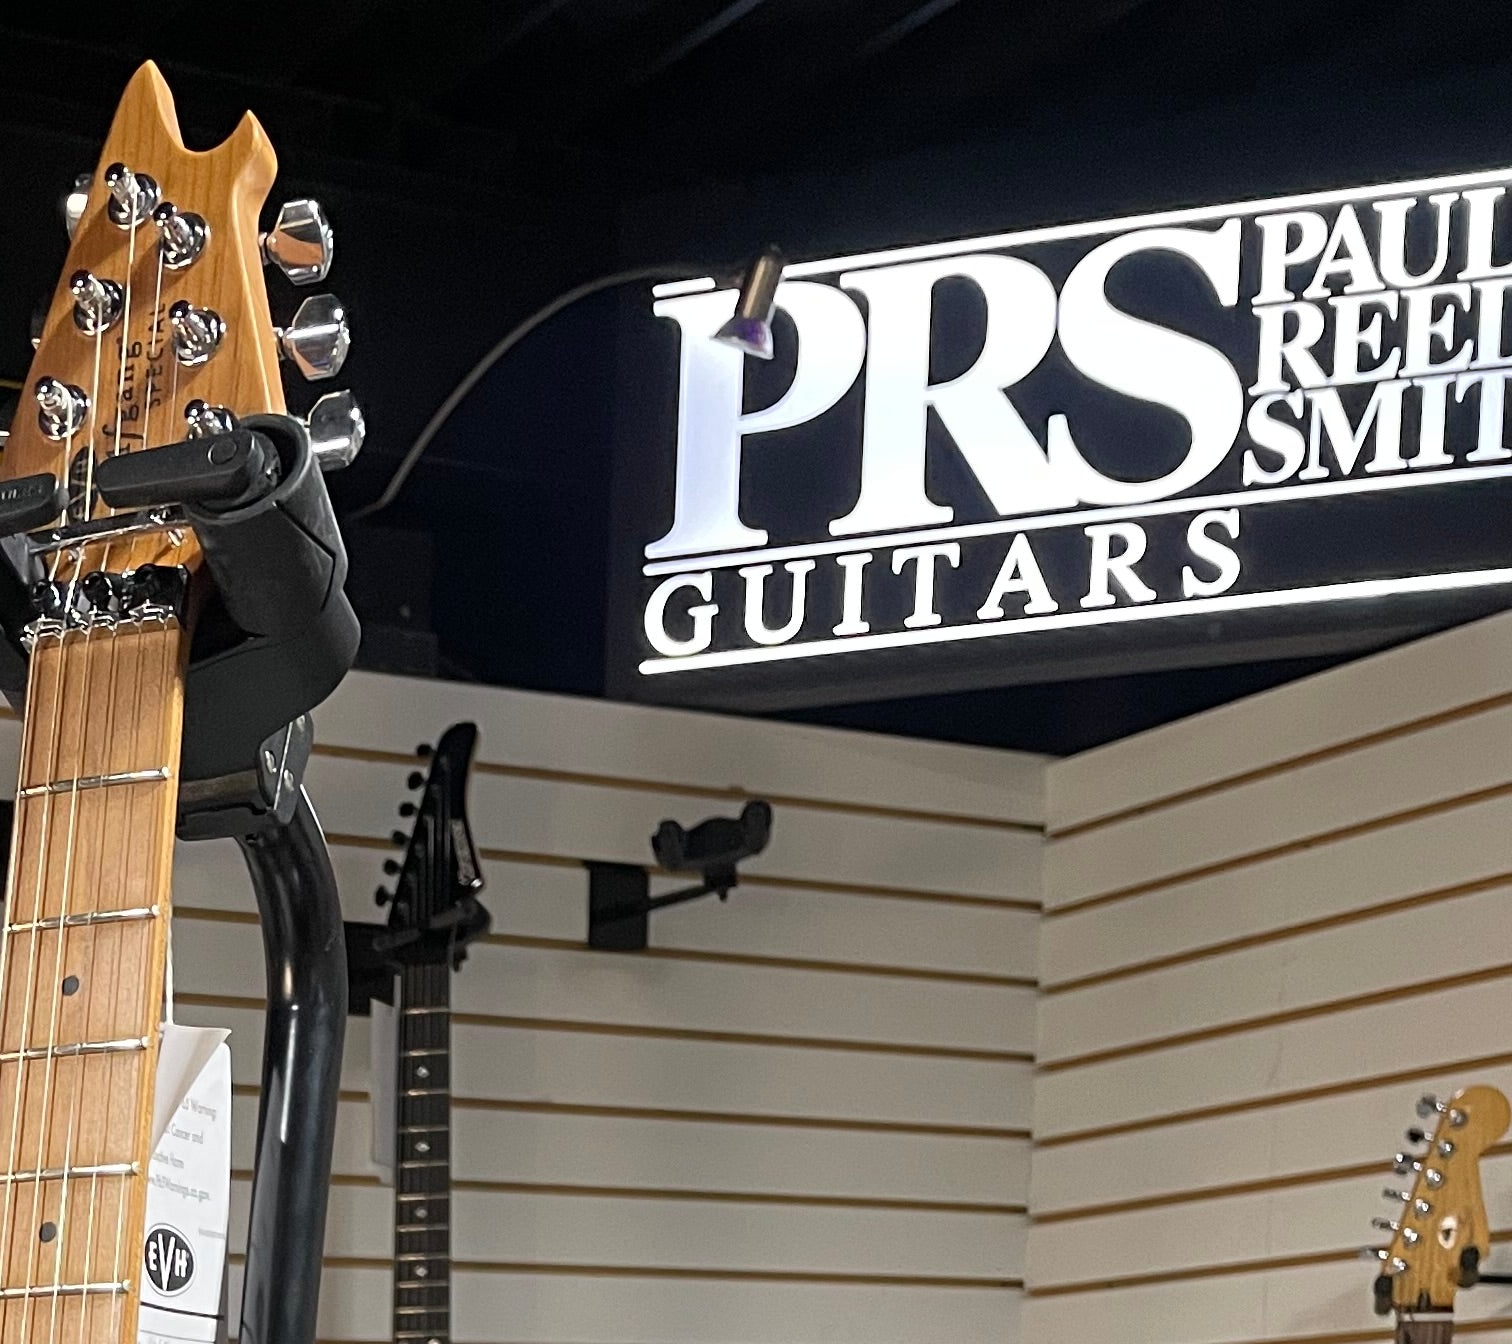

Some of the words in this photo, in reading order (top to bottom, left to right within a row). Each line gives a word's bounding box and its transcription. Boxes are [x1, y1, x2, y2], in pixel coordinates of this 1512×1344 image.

[1251, 185, 1512, 307] PAUL
[644, 219, 1244, 559] PRS
[644, 508, 1243, 657] GUITARS
[148, 1233, 188, 1292] EVH
